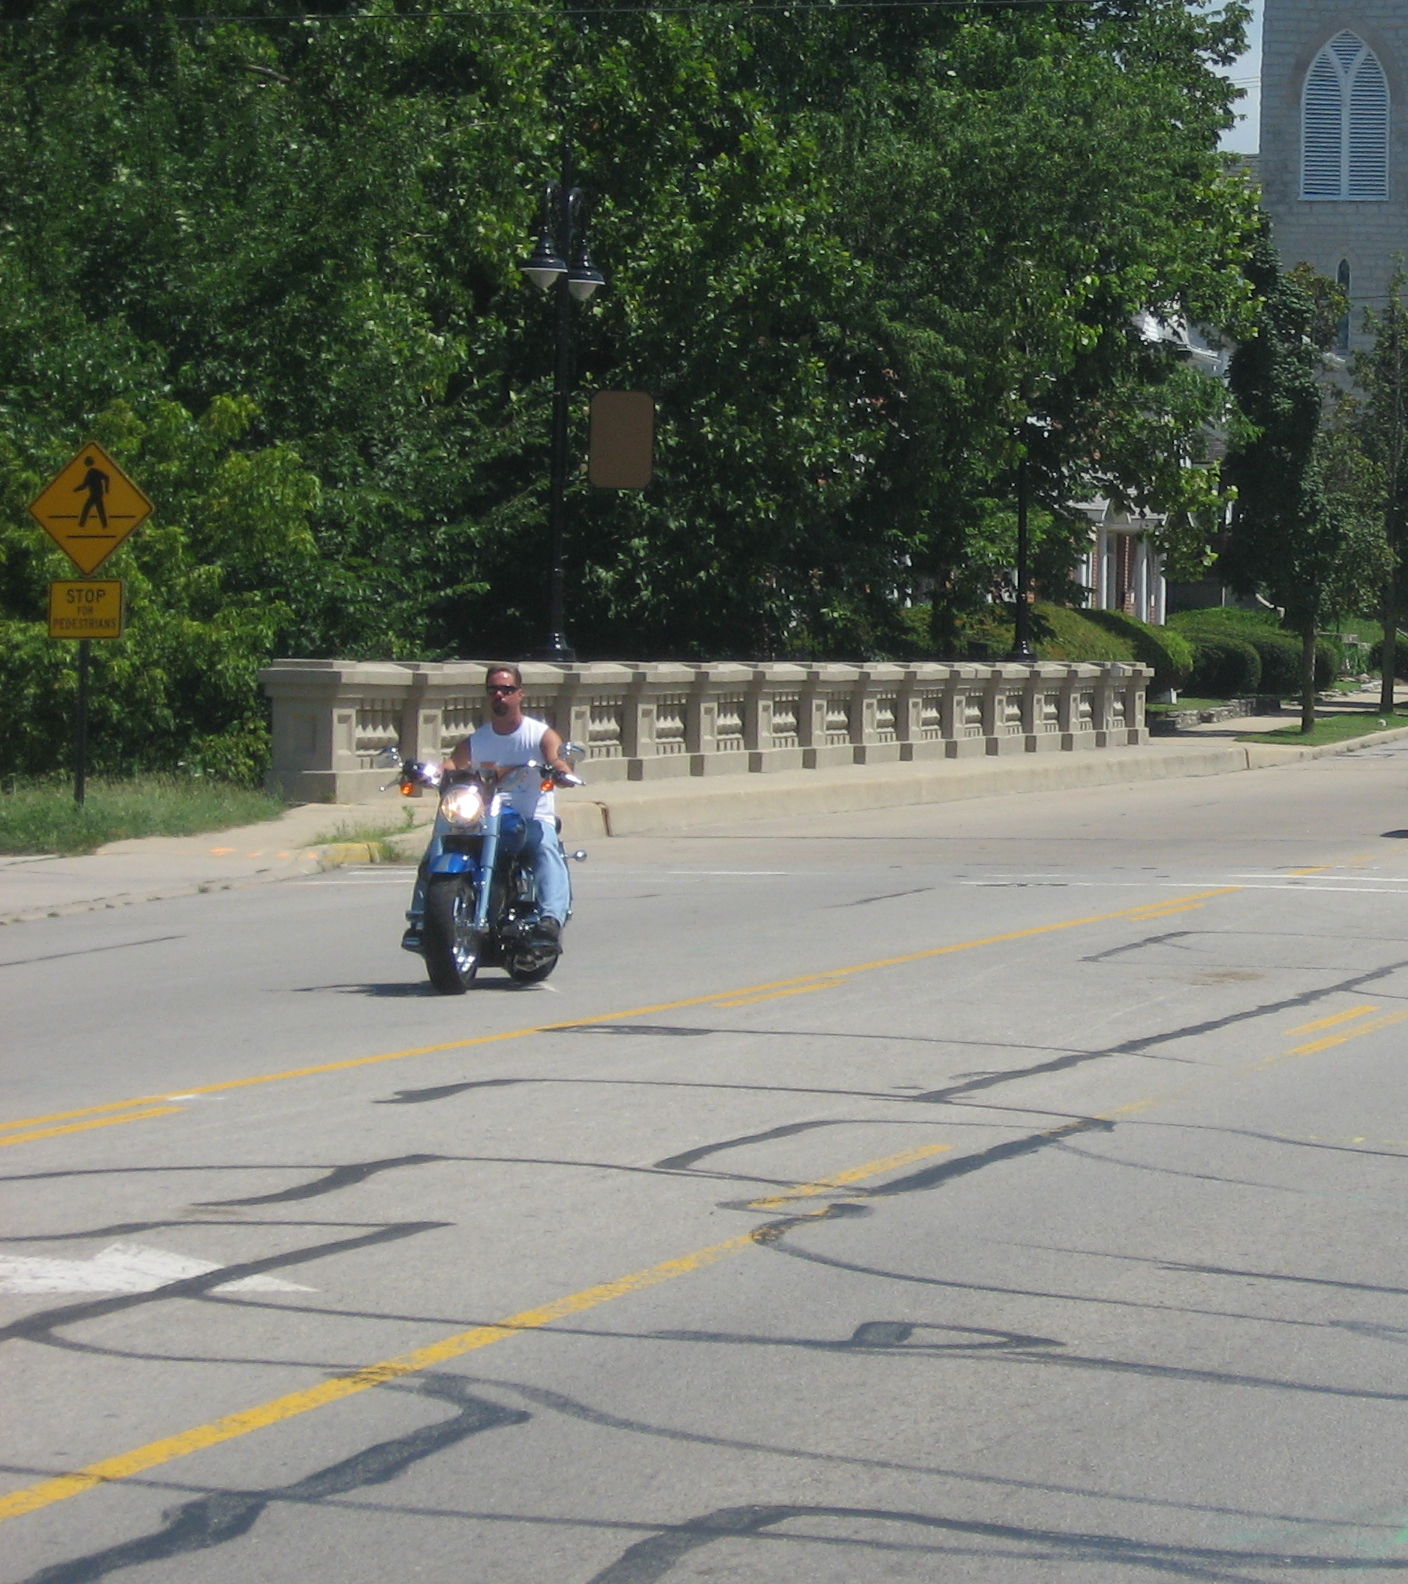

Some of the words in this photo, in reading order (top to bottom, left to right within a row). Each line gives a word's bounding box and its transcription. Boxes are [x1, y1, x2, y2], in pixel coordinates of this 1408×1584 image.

[66, 588, 106, 604] STOP
[77, 606, 94, 616] FOR
[53, 617, 117, 630] PEDESTRIANS
